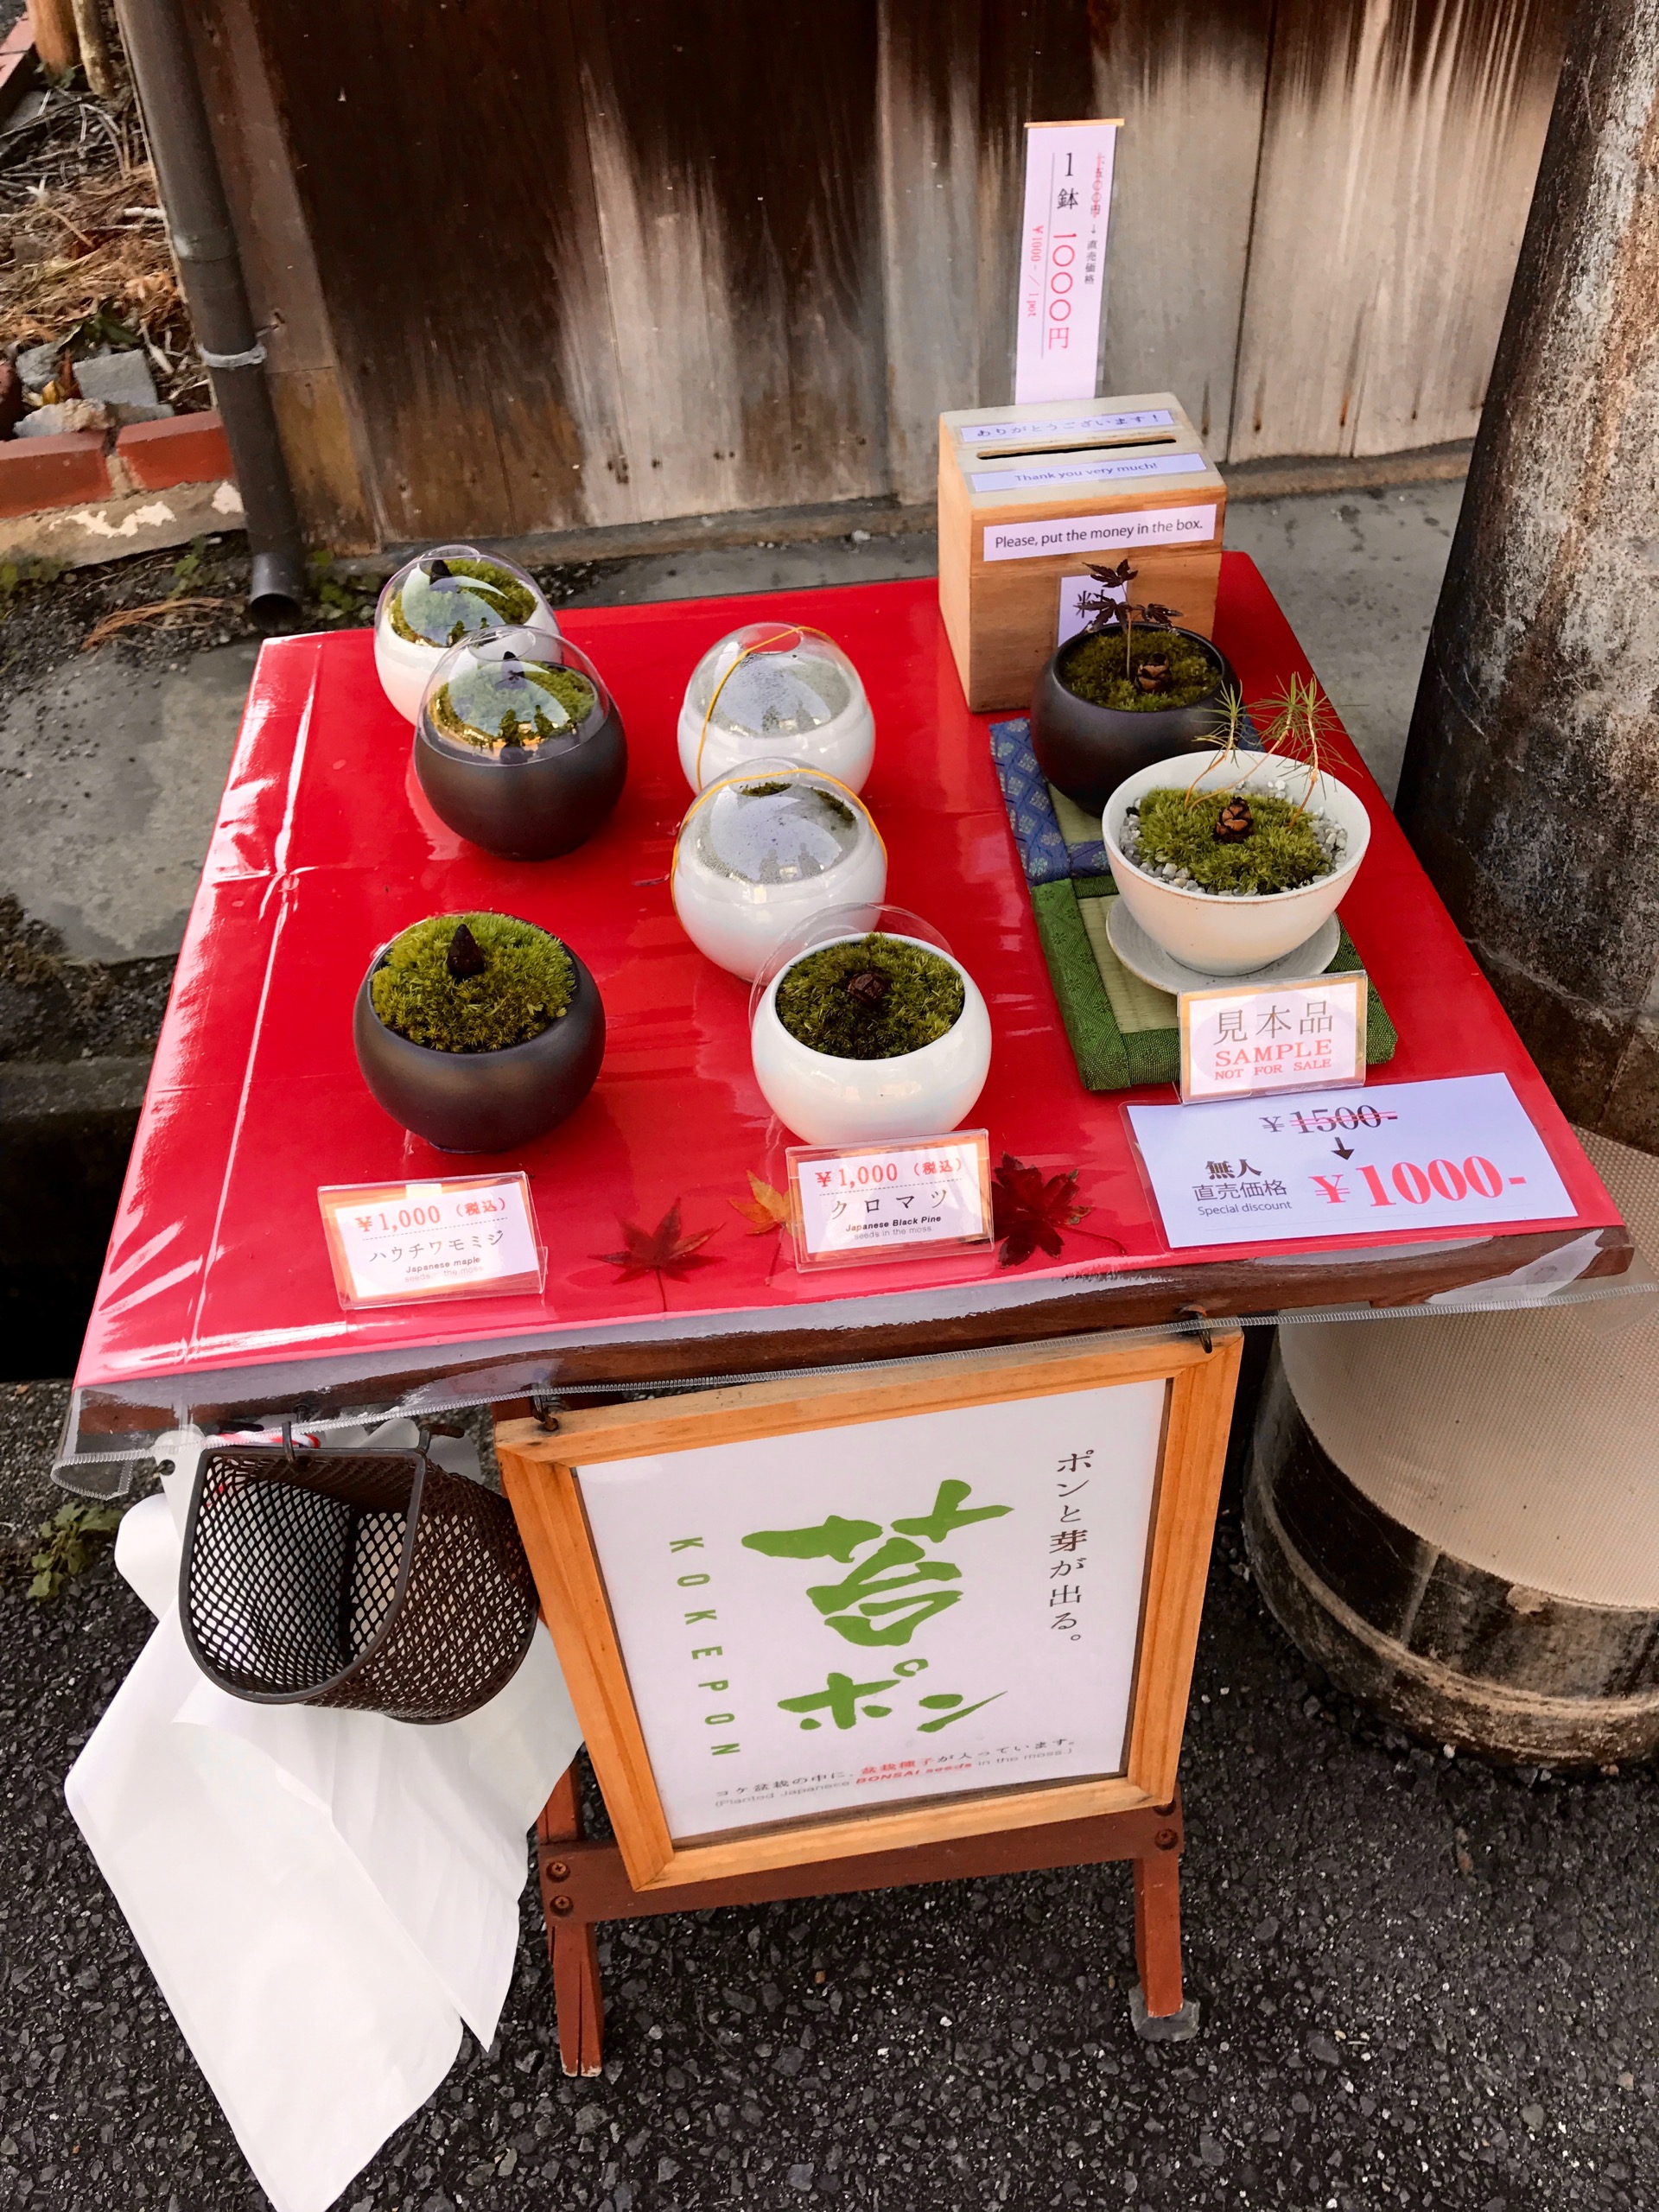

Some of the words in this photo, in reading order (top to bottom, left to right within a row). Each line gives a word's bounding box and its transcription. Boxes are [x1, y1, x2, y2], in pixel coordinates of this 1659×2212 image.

[1014, 471, 1055, 482] Thank
[1058, 470, 1082, 480] you
[1085, 467, 1113, 477] very
[1116, 462, 1158, 472] much!
[995, 535, 1038, 550] Please,
[1041, 532, 1063, 546] put
[1066, 529, 1087, 542] the
[1090, 524, 1135, 540] money
[1137, 523, 1149, 535] in
[1152, 521, 1173, 533] the
[1176, 518, 1204, 531] box.
[1213, 1000, 1333, 1046] 見本品
[1215, 1039, 1332, 1067] SAMPLE
[1214, 1068, 1244, 1080] NOT
[1254, 1065, 1283, 1076] FOR
[1293, 1058, 1332, 1071] SALE
[815, 1163, 898, 1189] ¥1,000
[1205, 1159, 1262, 1179] 無人
[1192, 1179, 1287, 1202] 直売価格
[831, 1189, 947, 1220] クロマツ
[1198, 1203, 1239, 1217] Special
[1242, 1200, 1293, 1213] discount
[354, 1205, 441, 1232] ¥1,000
[845, 1221, 890, 1232] Japanese
[893, 1217, 918, 1227] Black
[921, 1215, 942, 1224] Pine
[368, 1230, 505, 1262] ハウチワモミジ
[854, 1230, 880, 1241] seeds
[909, 1225, 931, 1234] moss
[406, 1262, 450, 1274] Japanese
[453, 1256, 480, 1267] maple
[1049, 1449, 1095, 1642] ポンと芽が出る。
[669, 1536, 741, 1756] KOKEPON
[780, 1780, 850, 1796] Japanese
[855, 1770, 920, 1785] BONSAI
[926, 1763, 973, 1774] seeds
[978, 1758, 992, 1766] in
[996, 1752, 1019, 1764] the
